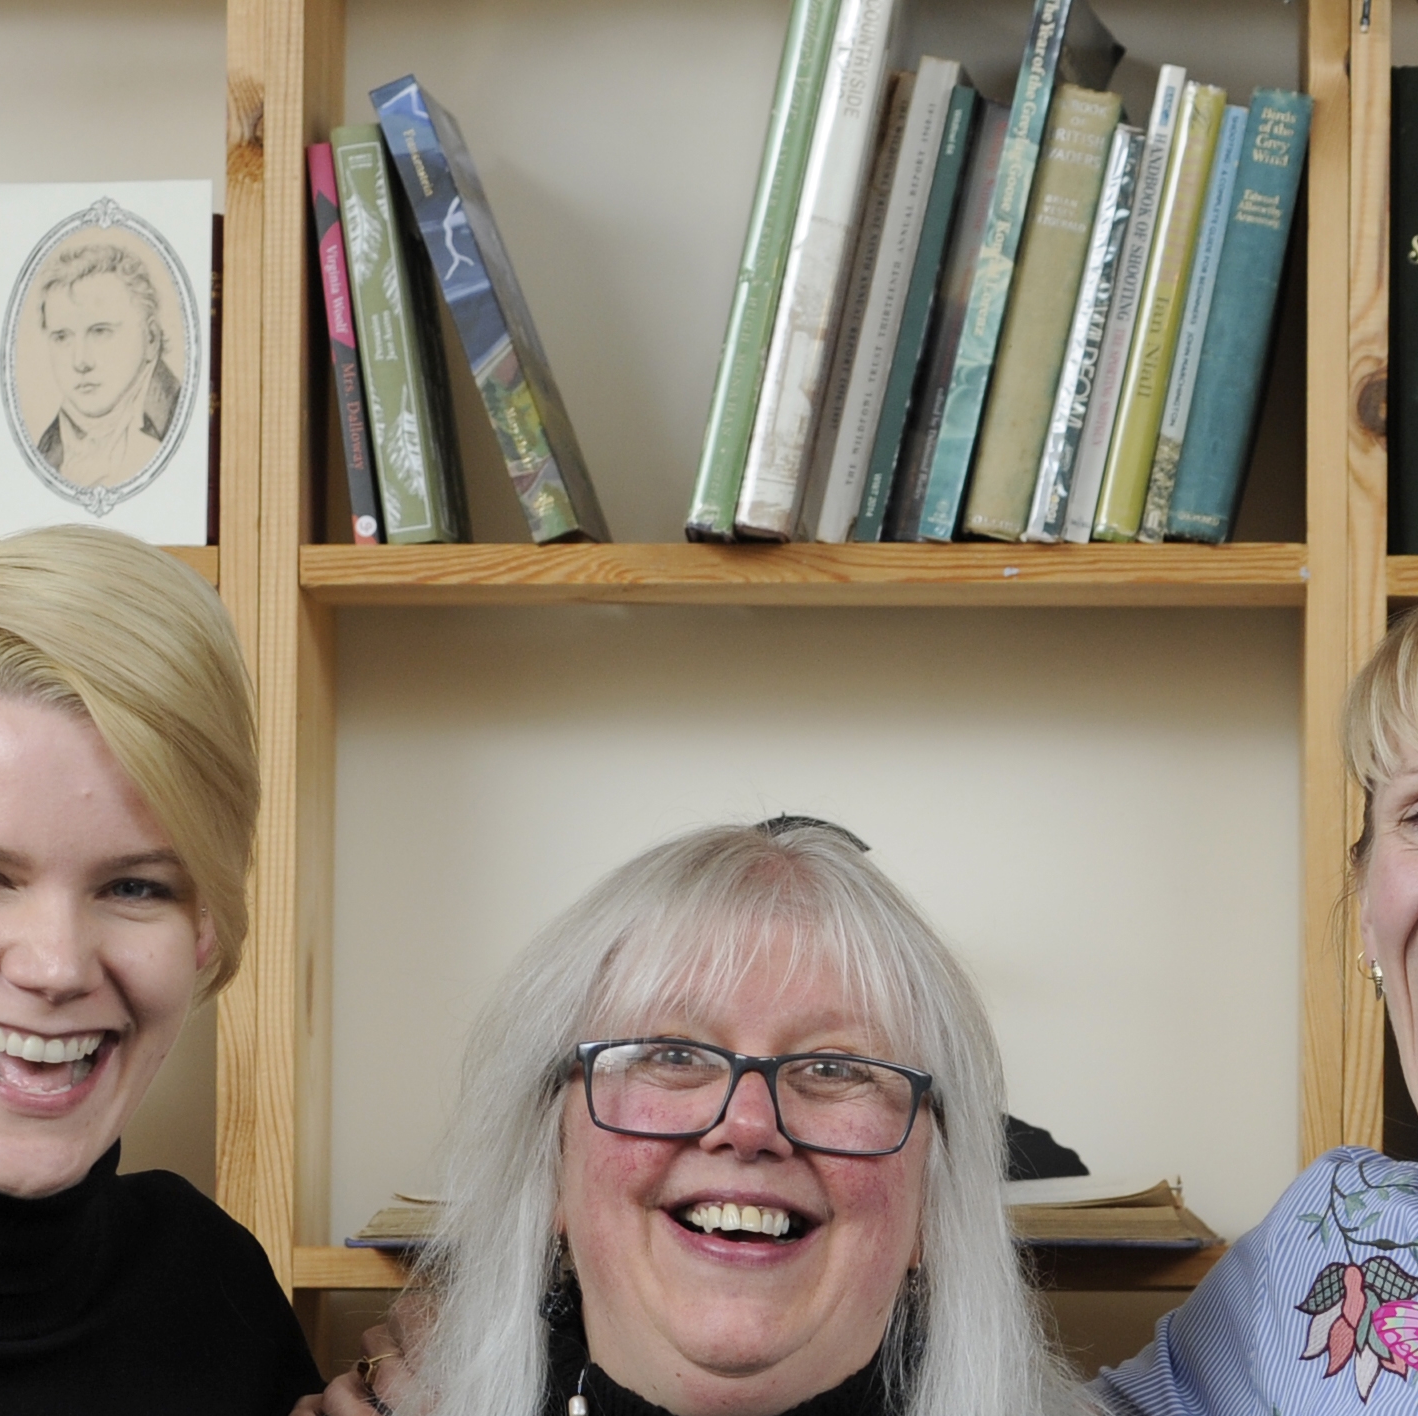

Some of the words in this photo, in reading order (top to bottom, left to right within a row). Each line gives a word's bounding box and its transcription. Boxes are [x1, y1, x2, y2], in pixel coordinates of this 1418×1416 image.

[1074, 101, 1110, 118] BOOK
[1259, 106, 1298, 124] Birds
[1255, 134, 1291, 158] Grey
[1258, 120, 1272, 136] of
[1271, 122, 1295, 138] the
[402, 127, 435, 198] Frankenstein
[1136, 131, 1168, 219] HANDBOOK
[1251, 148, 1291, 168] Wind
[1132, 220, 1150, 241] OF
[321, 244, 345, 295] Virginia
[1115, 242, 1145, 323] SHOOTING
[329, 296, 349, 334] Woolf
[1149, 295, 1170, 335] Ian
[340, 361, 358, 395] Mrs.
[1136, 341, 1161, 398] Niall
[341, 400, 368, 471] Dalloway
[868, 471, 882, 496] WWT
[864, 495, 877, 518] 2014
